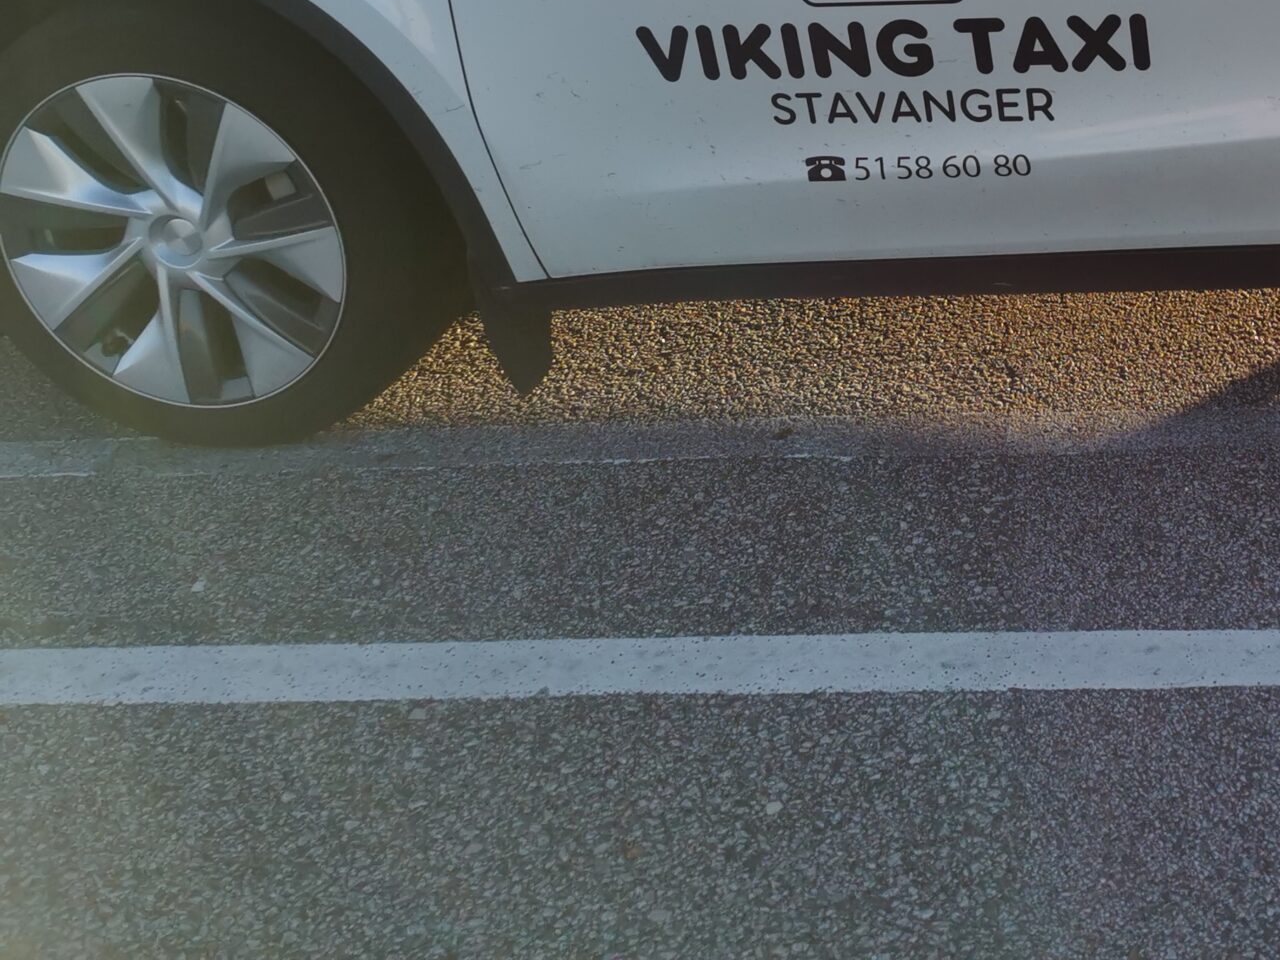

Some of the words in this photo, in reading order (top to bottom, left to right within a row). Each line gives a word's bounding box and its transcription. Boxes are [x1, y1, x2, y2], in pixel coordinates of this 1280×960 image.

[636, 19, 935, 82] VIKING
[953, 14, 1151, 74] TAXI
[770, 88, 1055, 125] STAVANGER
[941, 155, 981, 179] 60
[993, 153, 1032, 178] 80
